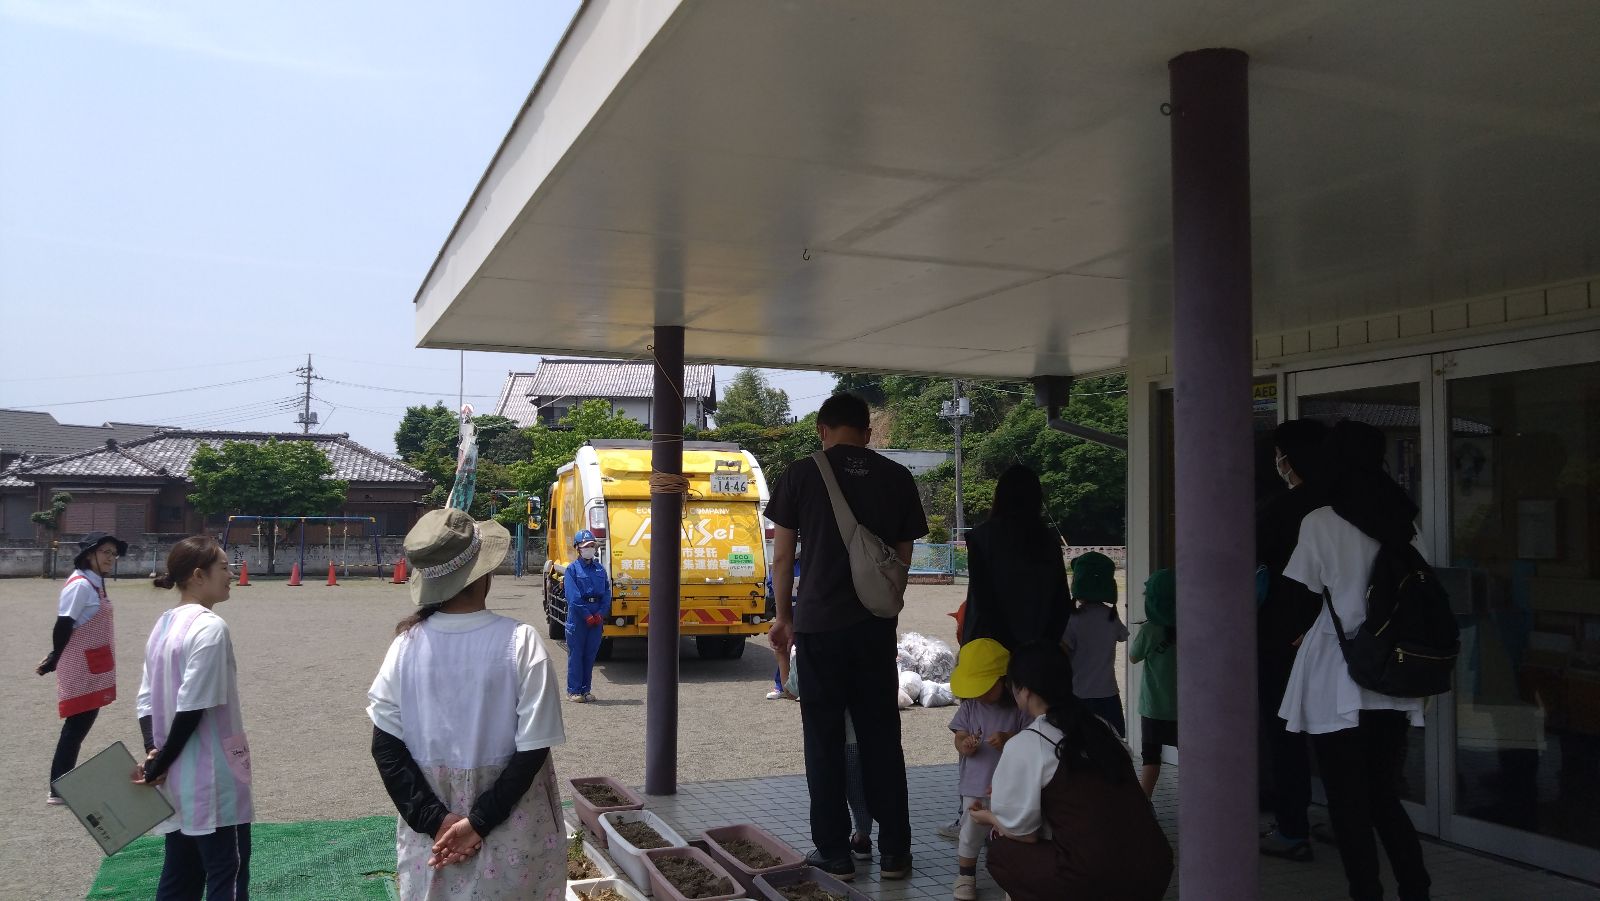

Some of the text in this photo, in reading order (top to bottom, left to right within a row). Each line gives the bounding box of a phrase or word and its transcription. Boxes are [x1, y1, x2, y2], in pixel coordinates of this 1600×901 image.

[1254, 385, 1277, 398] AED
[718, 480, 746, 492] 14-46
[690, 507, 730, 515] COMPANY
